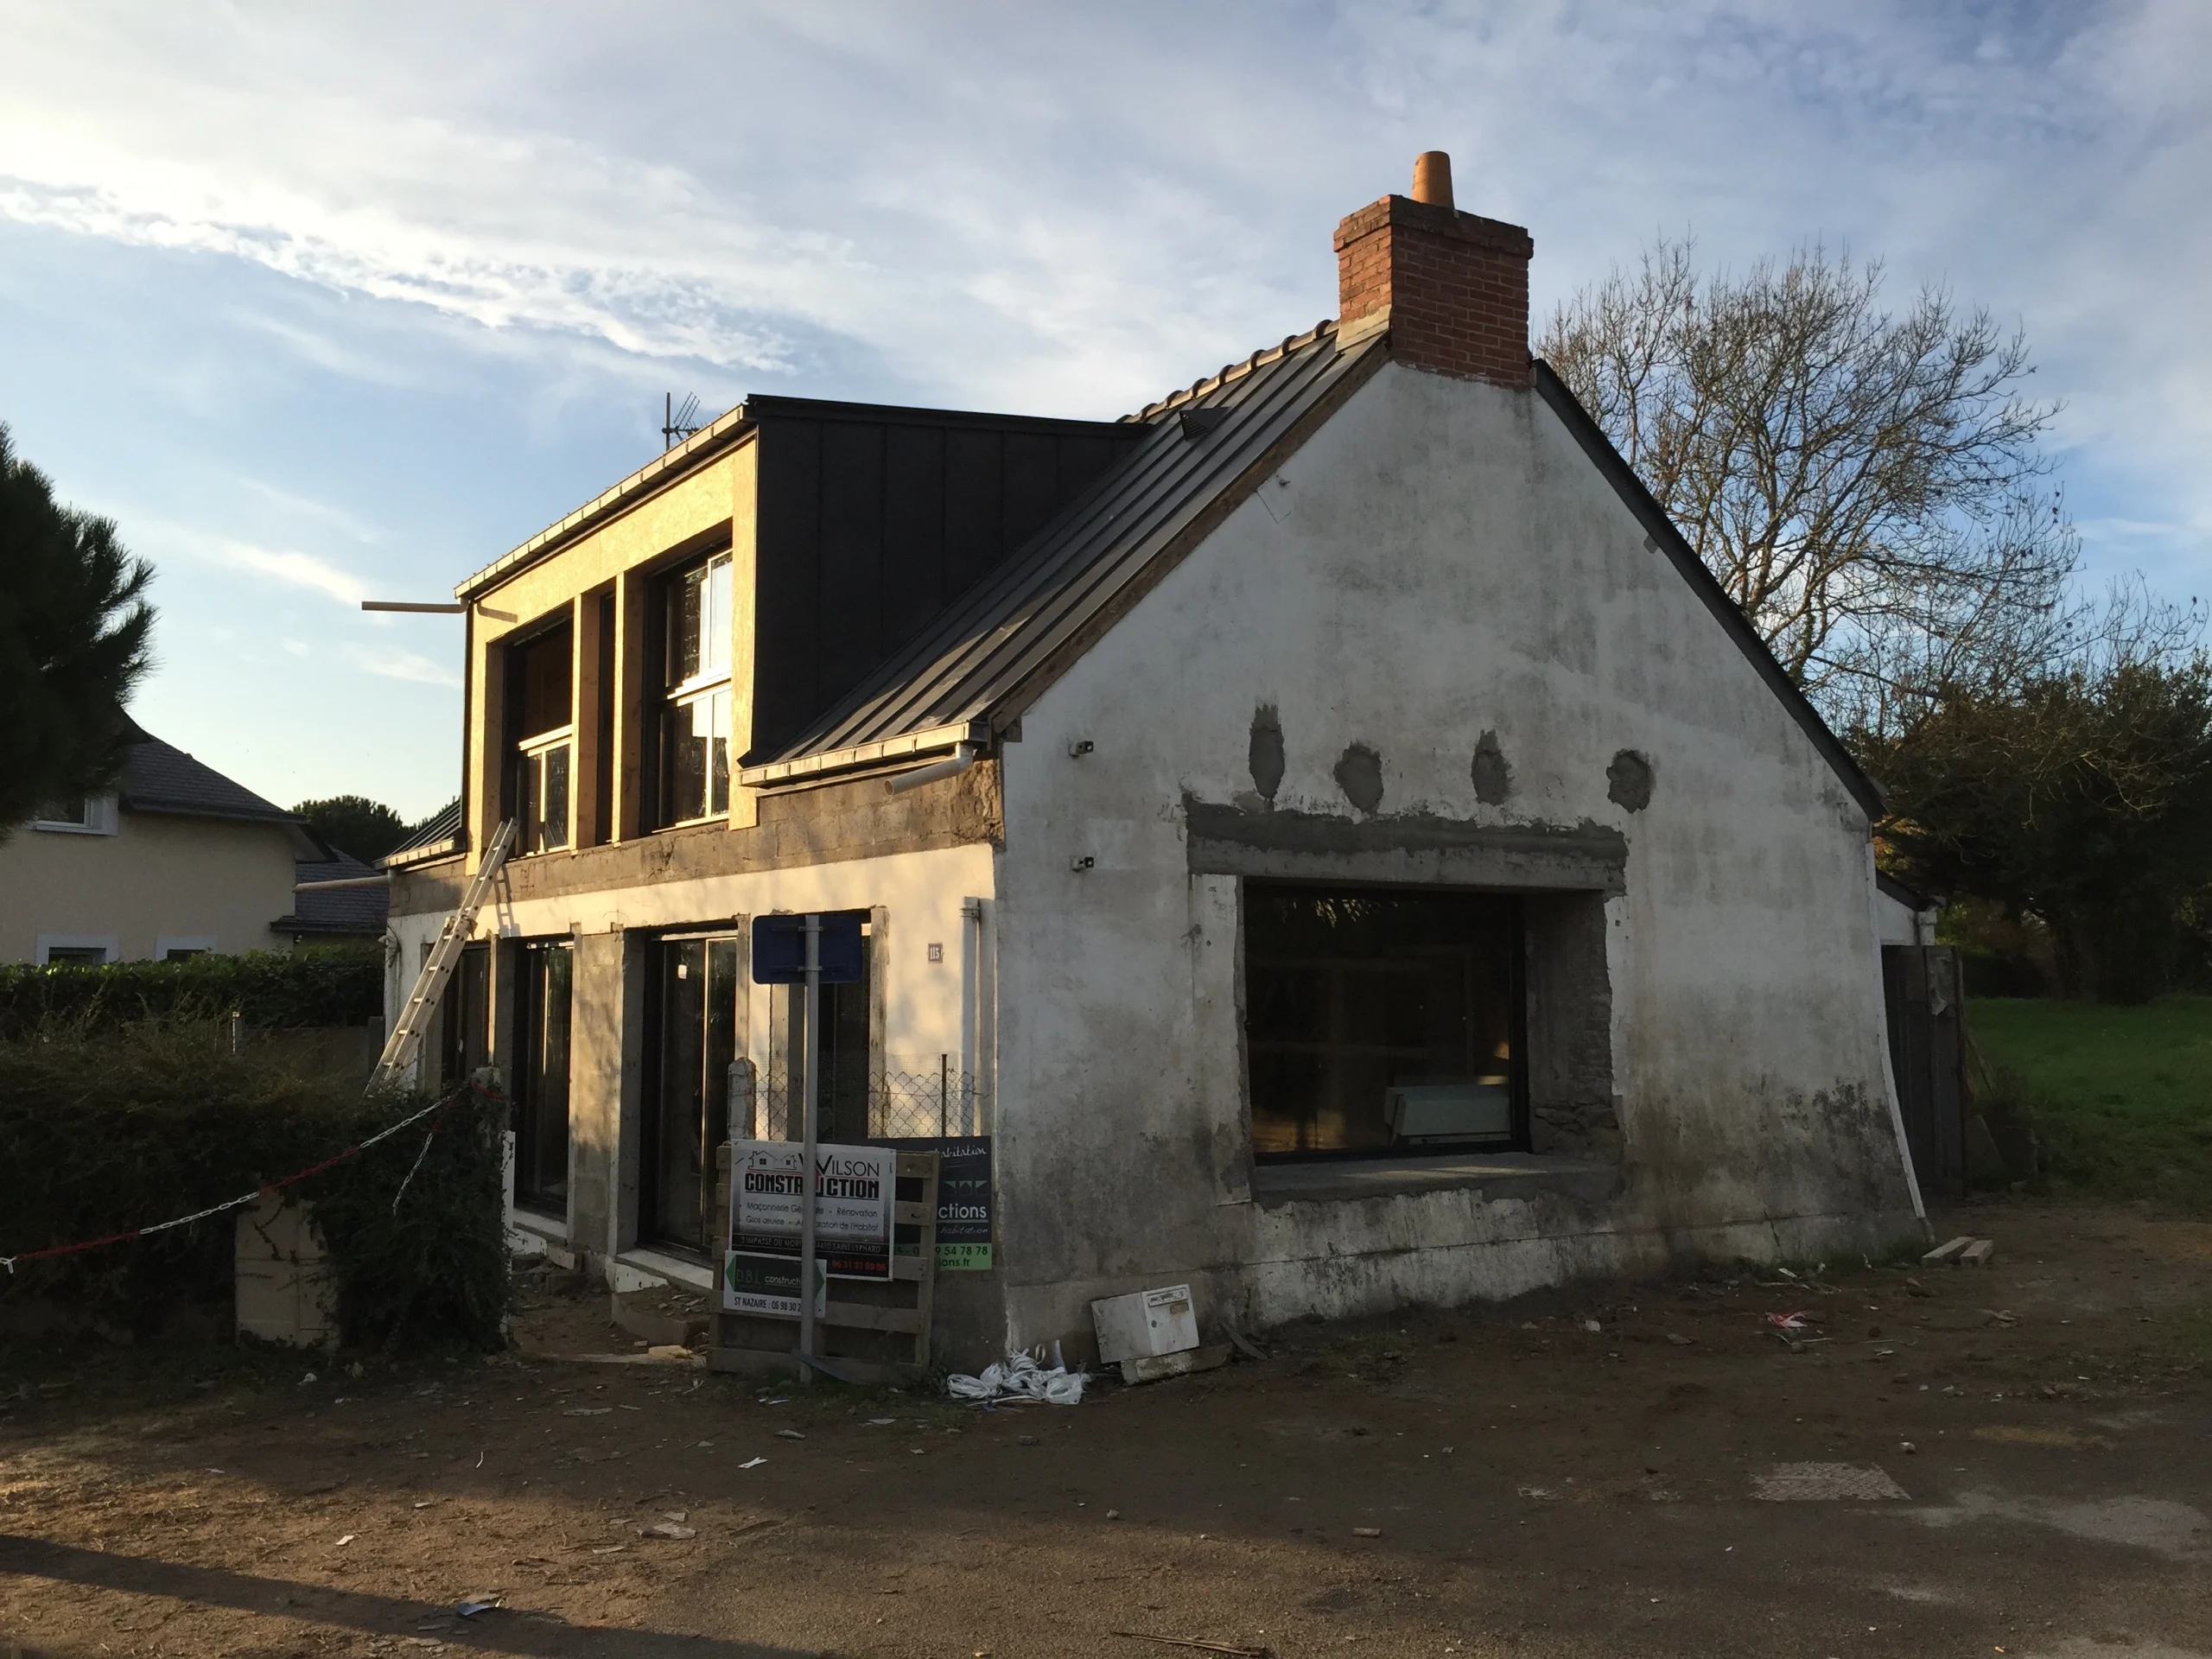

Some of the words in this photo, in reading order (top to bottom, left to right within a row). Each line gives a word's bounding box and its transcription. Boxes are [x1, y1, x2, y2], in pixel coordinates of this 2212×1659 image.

[930, 946, 940, 960] 115
[936, 1145, 987, 1158] abitation
[798, 1154, 880, 1177] WILSON
[747, 1202, 789, 1212] Maçonnerie
[836, 1206, 878, 1217] Rénovation
[938, 1202, 987, 1219] ctions
[746, 1215, 760, 1224] Gros
[840, 1221, 849, 1230] de
[940, 1224, 988, 1234] habitation
[746, 1236, 772, 1246] IMPASSE
[832, 1242, 851, 1251] SAINT
[852, 1243, 881, 1253] LYPHARD
[944, 1246, 957, 1255] 54
[960, 1246, 972, 1255] 78
[976, 1246, 988, 1255] 78
[765, 1275, 801, 1286] constructi
[734, 1297, 741, 1306] ST
[742, 1298, 766, 1308] NAZAIRE
